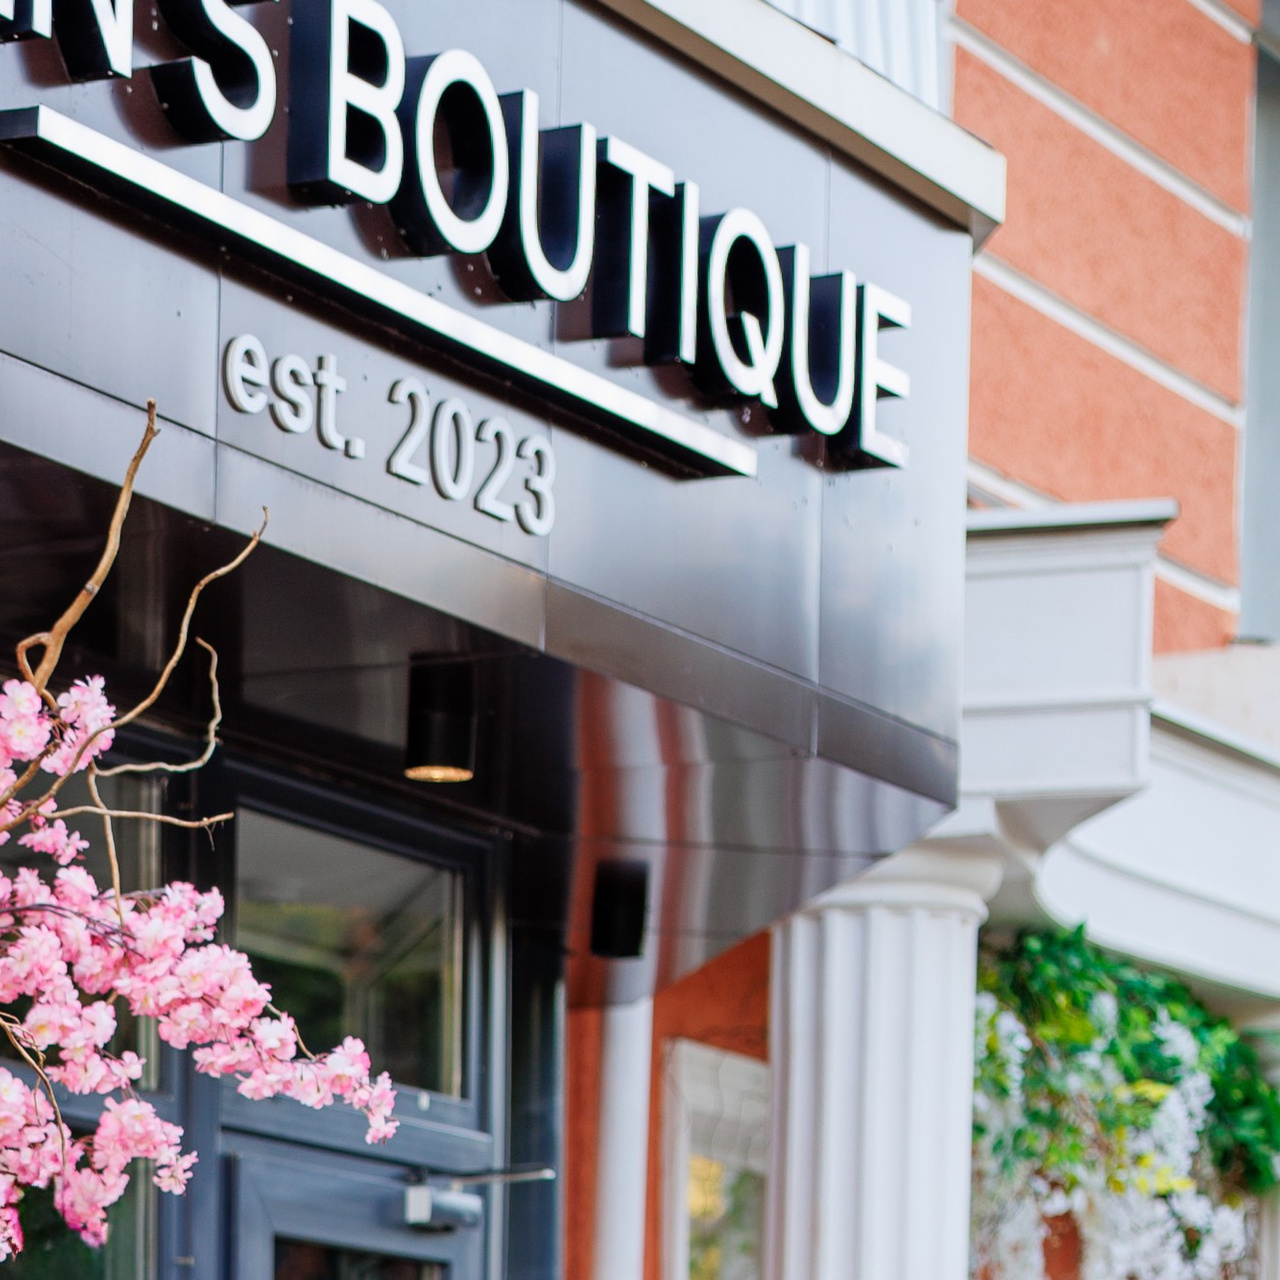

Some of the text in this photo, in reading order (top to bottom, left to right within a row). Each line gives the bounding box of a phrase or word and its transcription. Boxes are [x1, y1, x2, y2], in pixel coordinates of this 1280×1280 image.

[324, 0, 912, 468] BOUTIQUE
[222, 333, 557, 536] est. 2023
